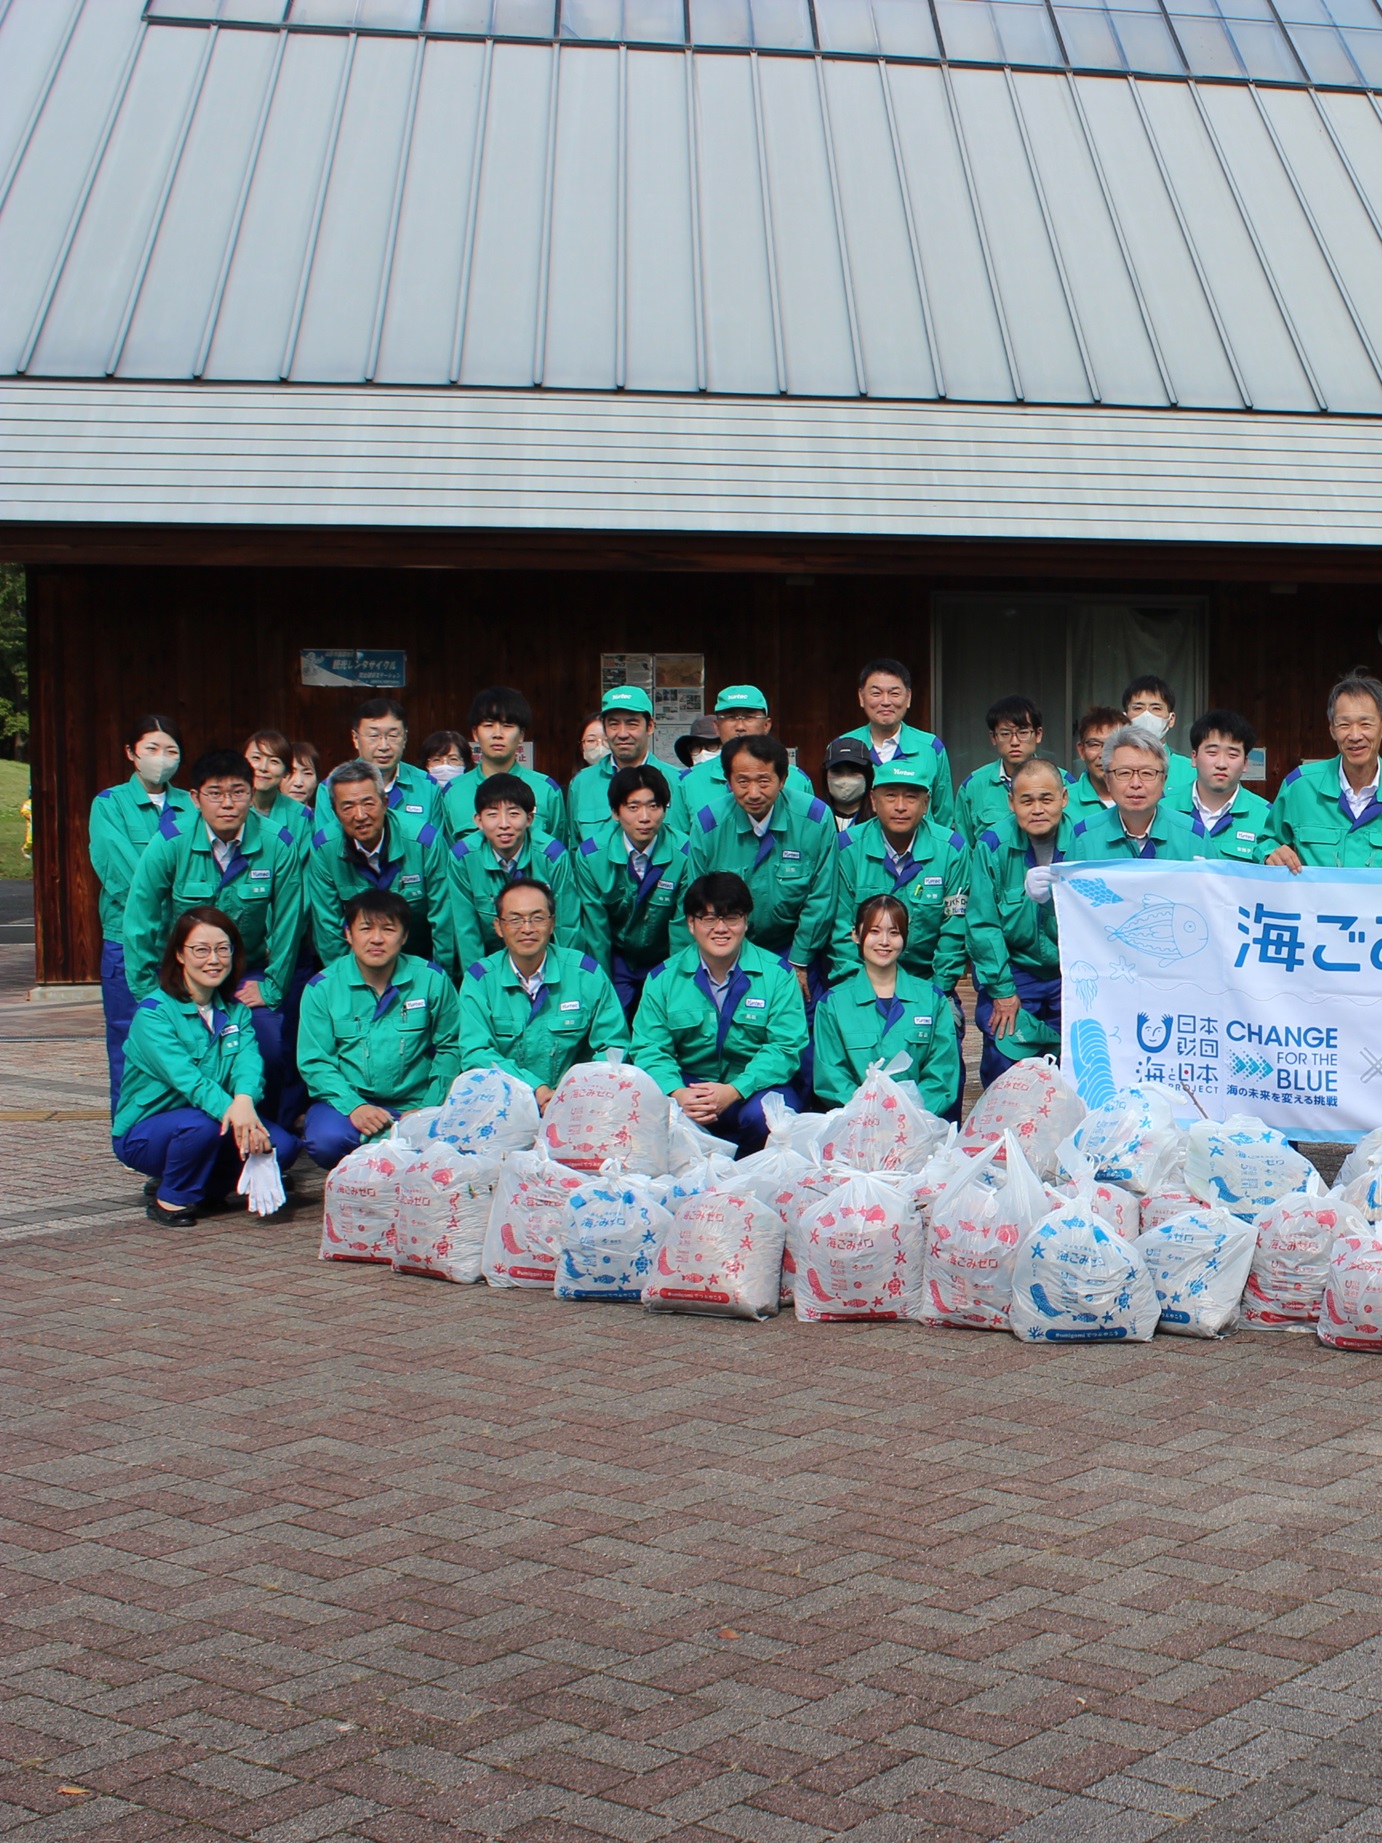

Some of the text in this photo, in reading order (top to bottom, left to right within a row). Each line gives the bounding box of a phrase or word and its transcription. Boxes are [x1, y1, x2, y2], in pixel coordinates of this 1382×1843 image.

[1177, 1014, 1218, 1035] 日本
[1226, 1020, 1338, 1048] CHANGE
[1177, 1037, 1218, 1058] 財団
[1277, 1052, 1338, 1066] FOR THE
[1277, 1069, 1338, 1092] BLUE
[1226, 1084, 1338, 1107] 海の未来を変える挑戦
